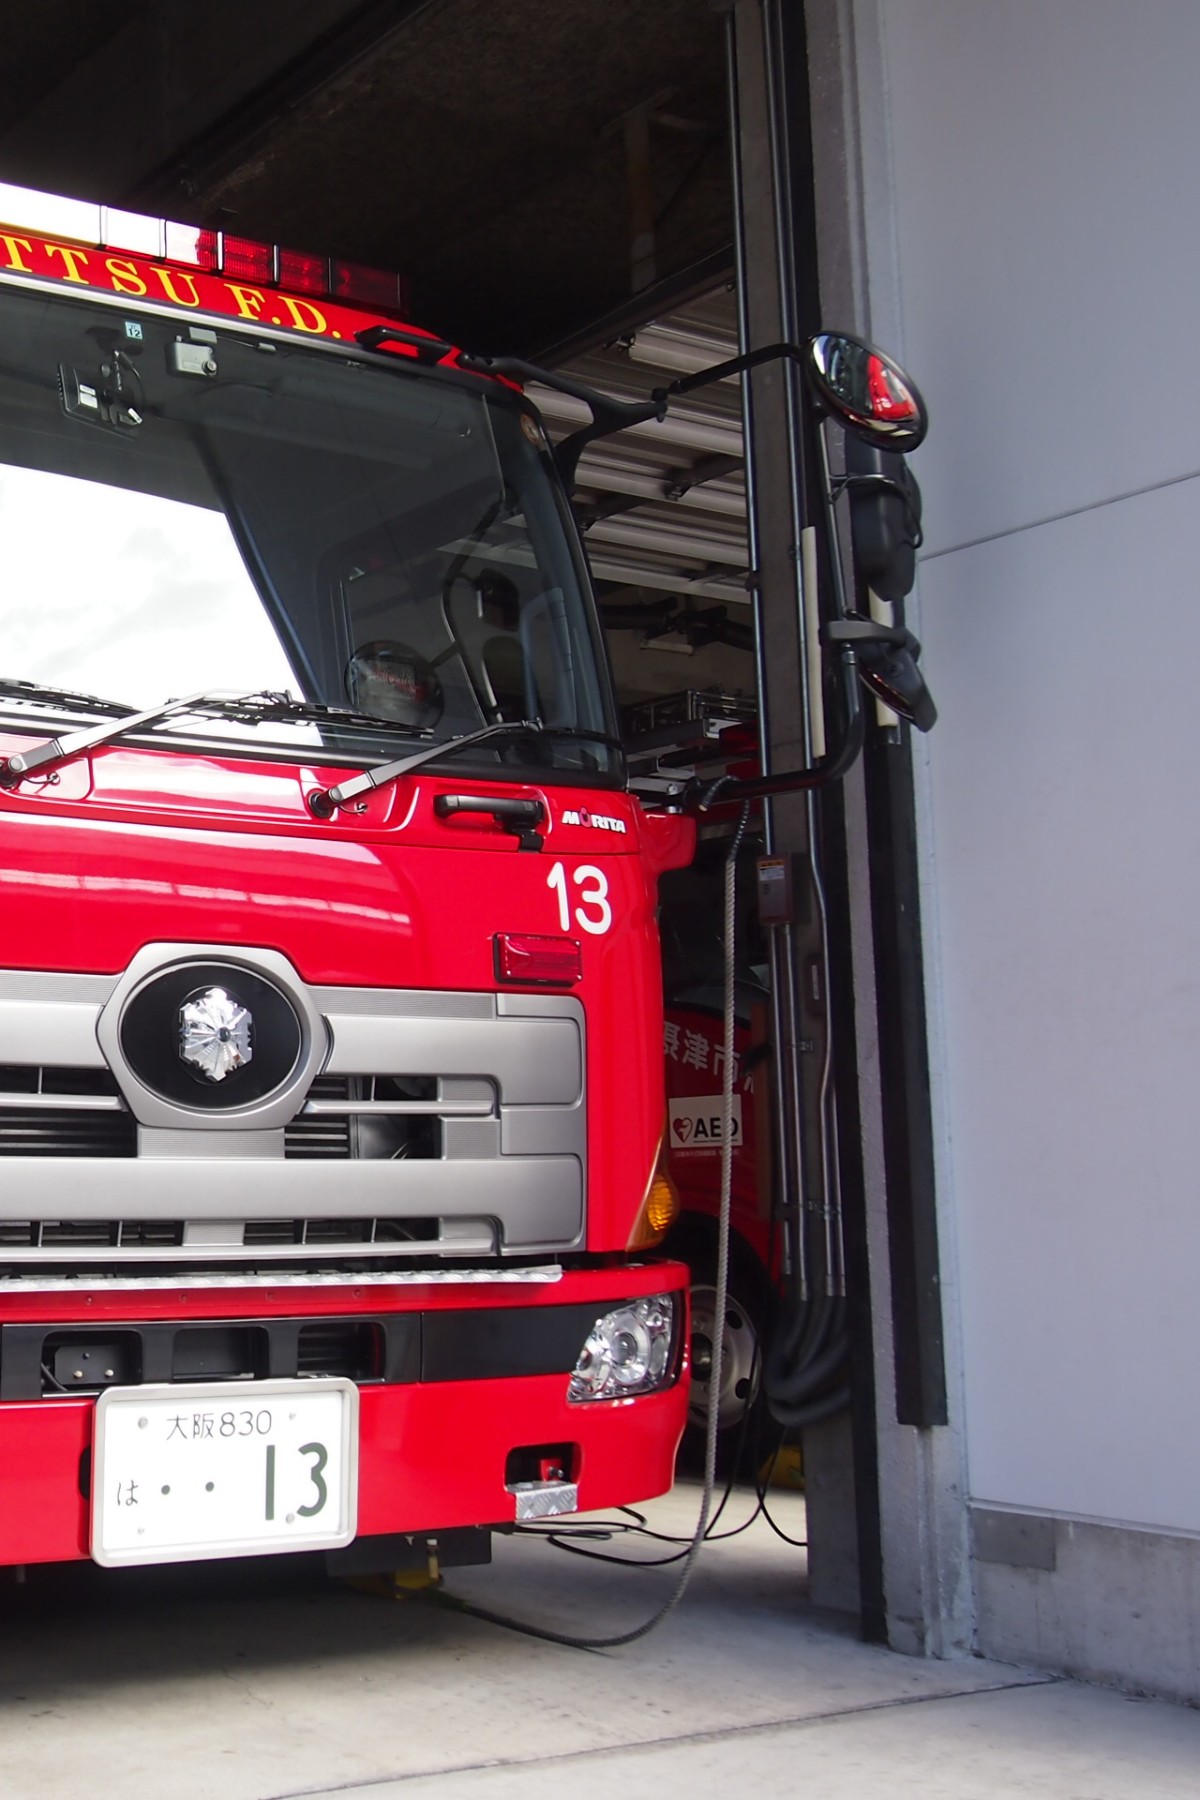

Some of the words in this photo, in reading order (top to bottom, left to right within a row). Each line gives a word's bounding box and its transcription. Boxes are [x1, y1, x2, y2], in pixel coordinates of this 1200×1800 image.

[224, 283, 342, 339] F.D.
[128, 328, 141, 338] 12
[561, 807, 627, 833] MORITA
[546, 861, 612, 935] 13
[117, 1480, 139, 1506] は
